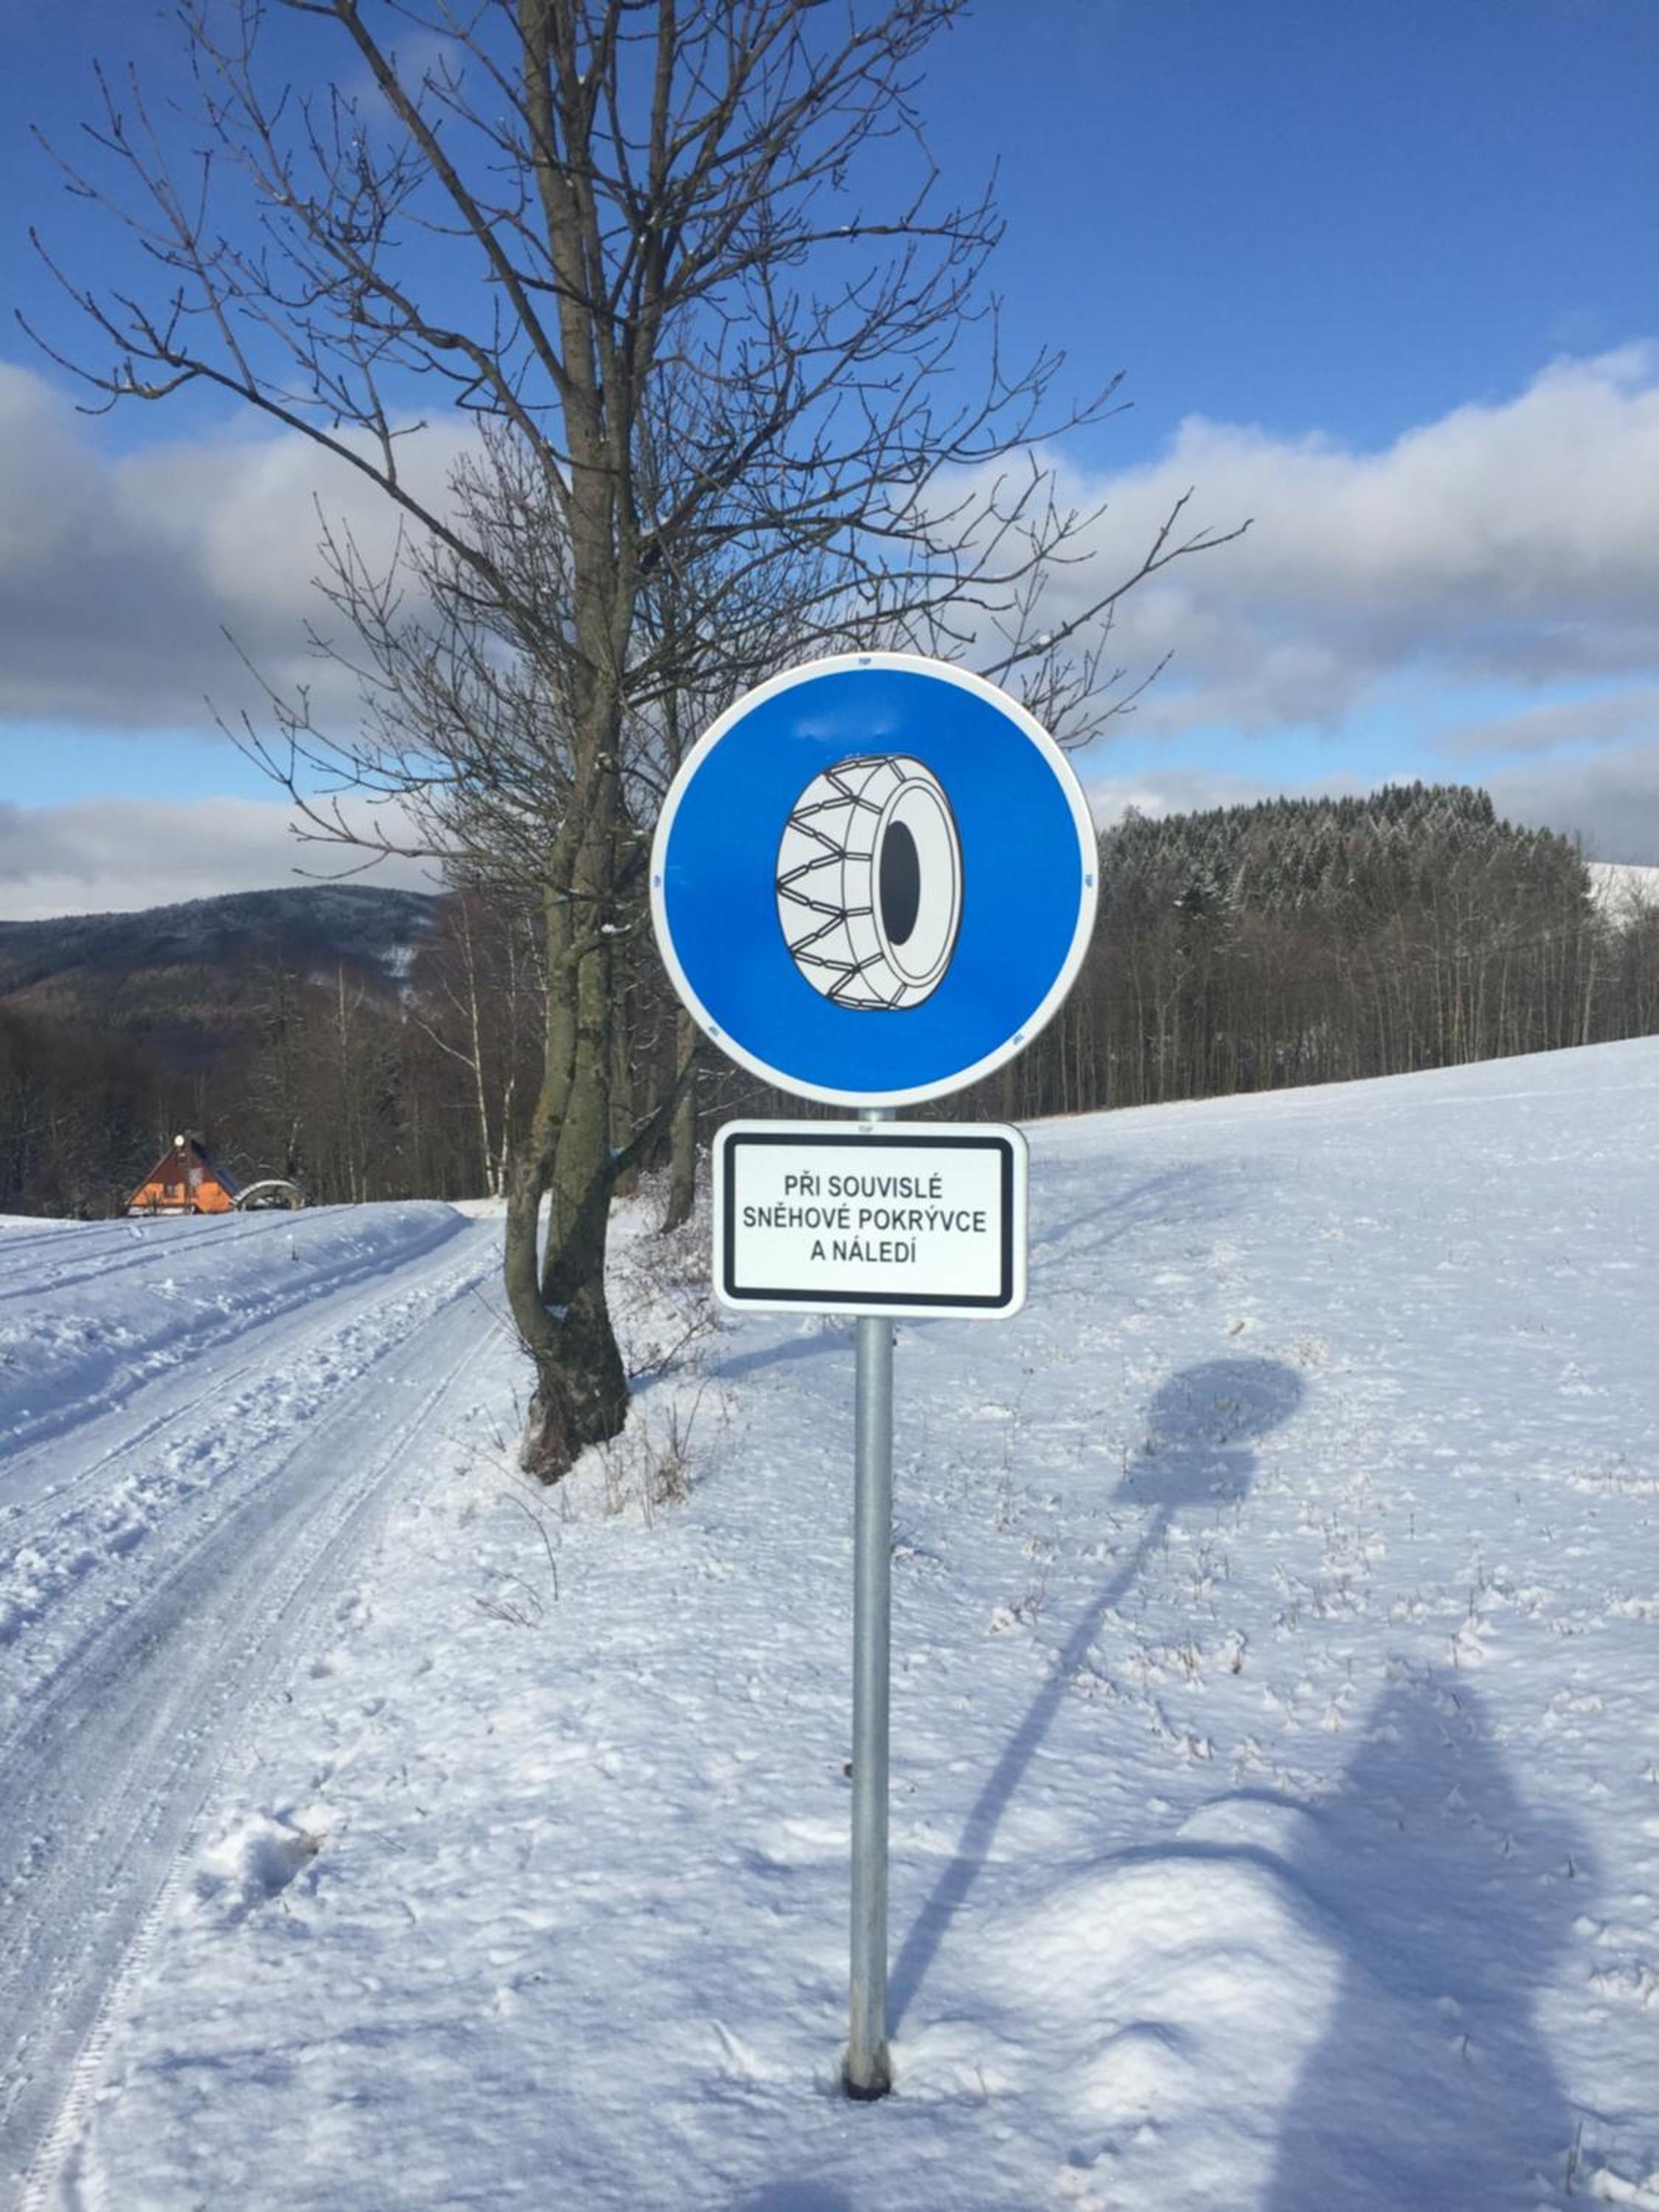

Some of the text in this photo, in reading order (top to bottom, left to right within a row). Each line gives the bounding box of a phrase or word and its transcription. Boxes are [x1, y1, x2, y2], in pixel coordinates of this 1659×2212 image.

[785, 1170, 942, 1199] PŘI SOUVISLÉ
[743, 1202, 986, 1233] SNĚHOVÉ POKRÝVCE
[810, 1235, 916, 1263] A NÁLEDÍ
